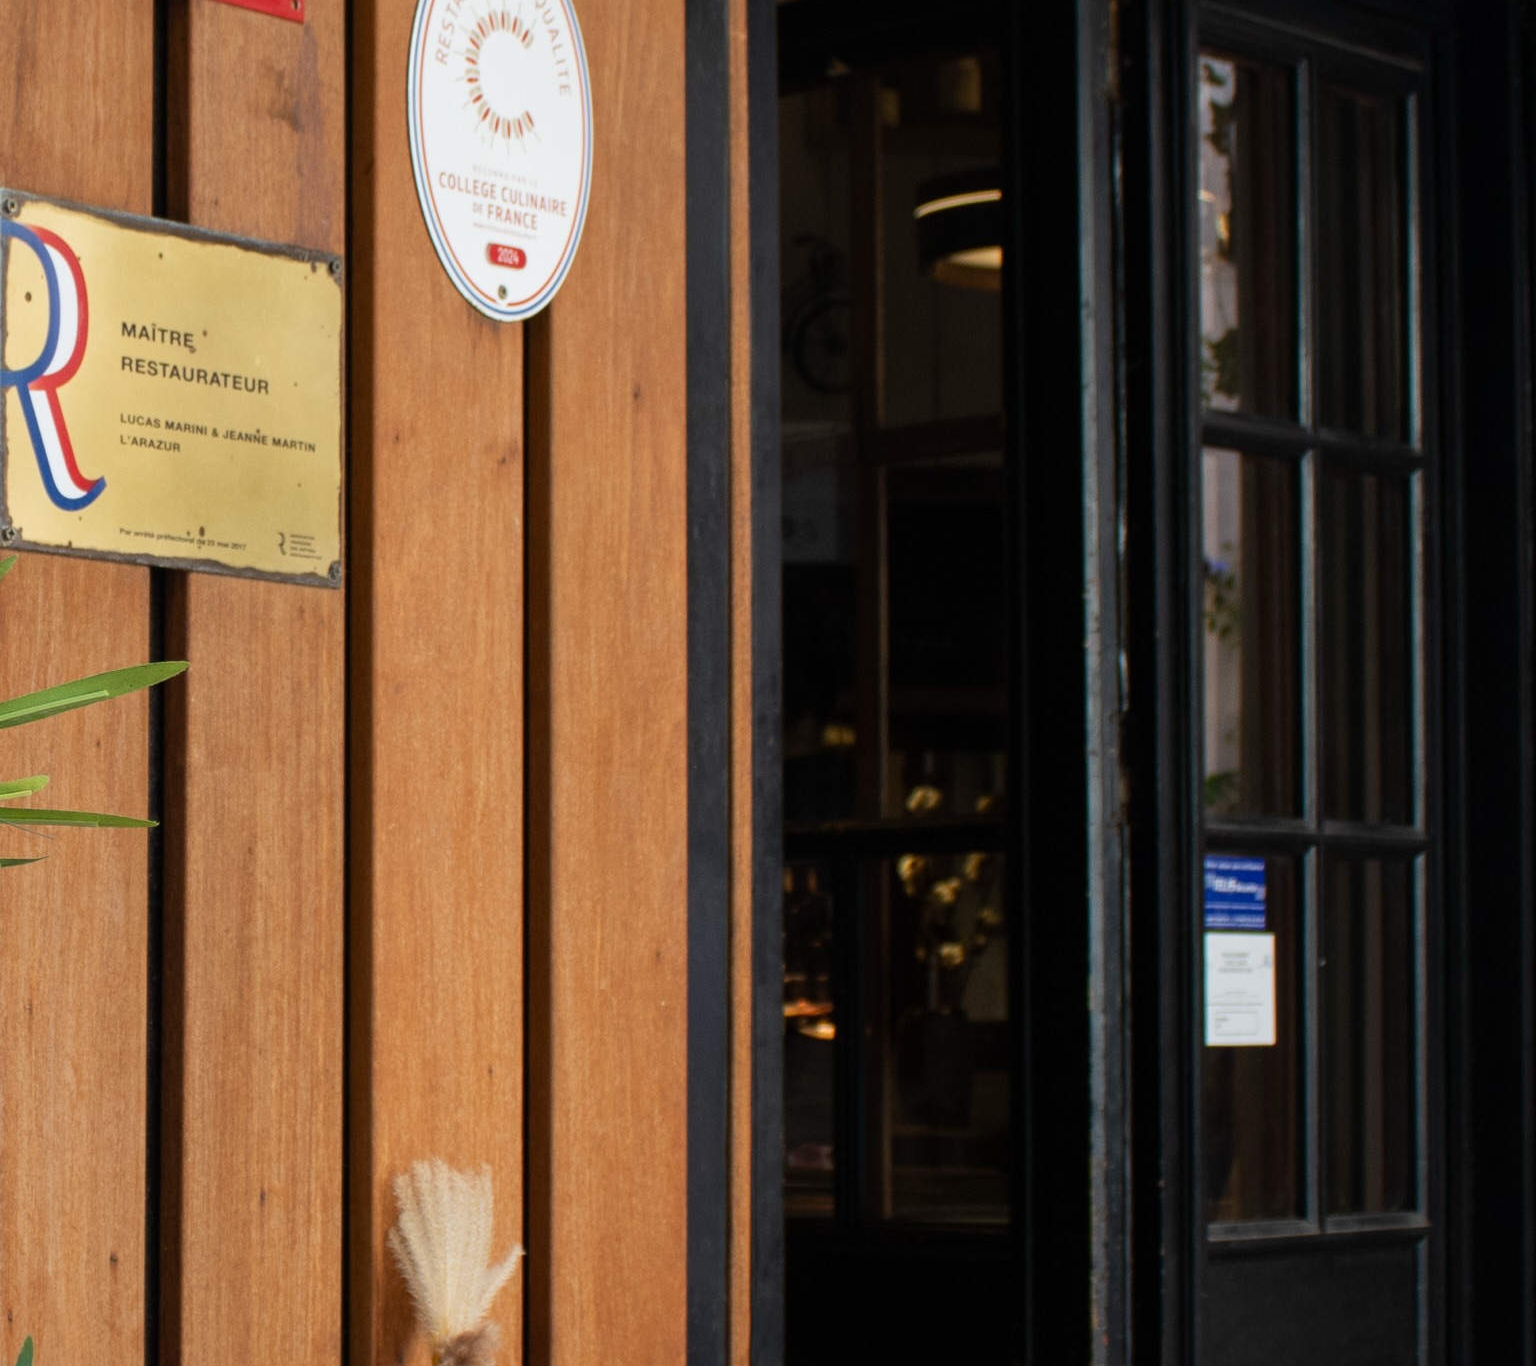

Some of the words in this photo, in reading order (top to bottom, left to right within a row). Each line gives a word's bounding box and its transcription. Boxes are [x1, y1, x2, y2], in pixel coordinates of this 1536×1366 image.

[439, 171, 497, 201] COLLEGE
[501, 186, 568, 217] CULINAIRE
[472, 202, 483, 215] DE
[487, 203, 538, 231] FRANCE
[497, 245, 520, 266] 2024
[121, 321, 195, 349] MAÎTRE
[121, 355, 270, 396] RESTAURATEUR
[120, 412, 161, 429] LUCAS
[165, 420, 208, 436] MARINI
[211, 427, 219, 438] &
[222, 429, 268, 446] JEANNE
[272, 437, 316, 453] MARTIN
[120, 434, 181, 453] L'ARAZUR
